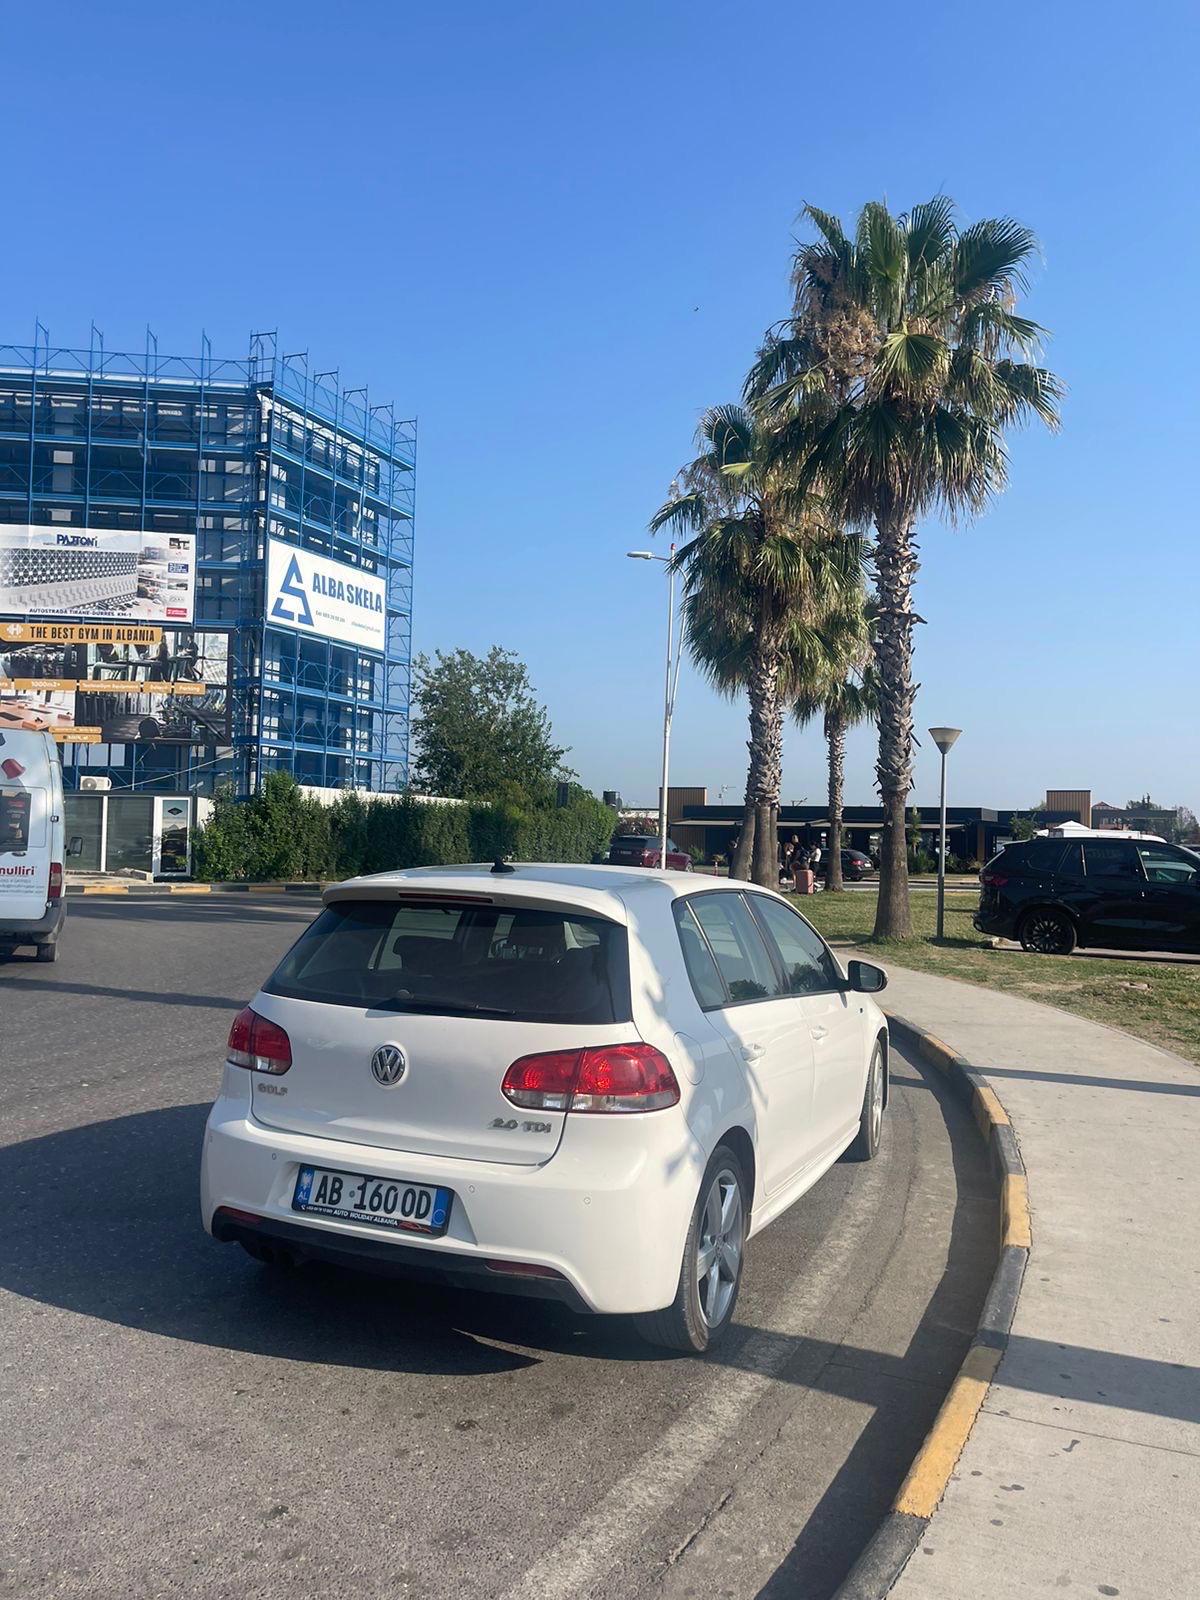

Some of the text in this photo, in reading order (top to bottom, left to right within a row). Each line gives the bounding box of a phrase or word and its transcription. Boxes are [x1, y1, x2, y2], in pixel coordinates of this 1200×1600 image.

[30, 626, 155, 641] THE BEST GYM IN ALBANIA
[257, 1083, 289, 1097] GOLF
[522, 1120, 552, 1133] TDI
[314, 1175, 344, 1206] AB
[333, 1209, 349, 1217] AUTO
[349, 1212, 374, 1222] HOLIDAY
[373, 1216, 398, 1226] ALBANIA
